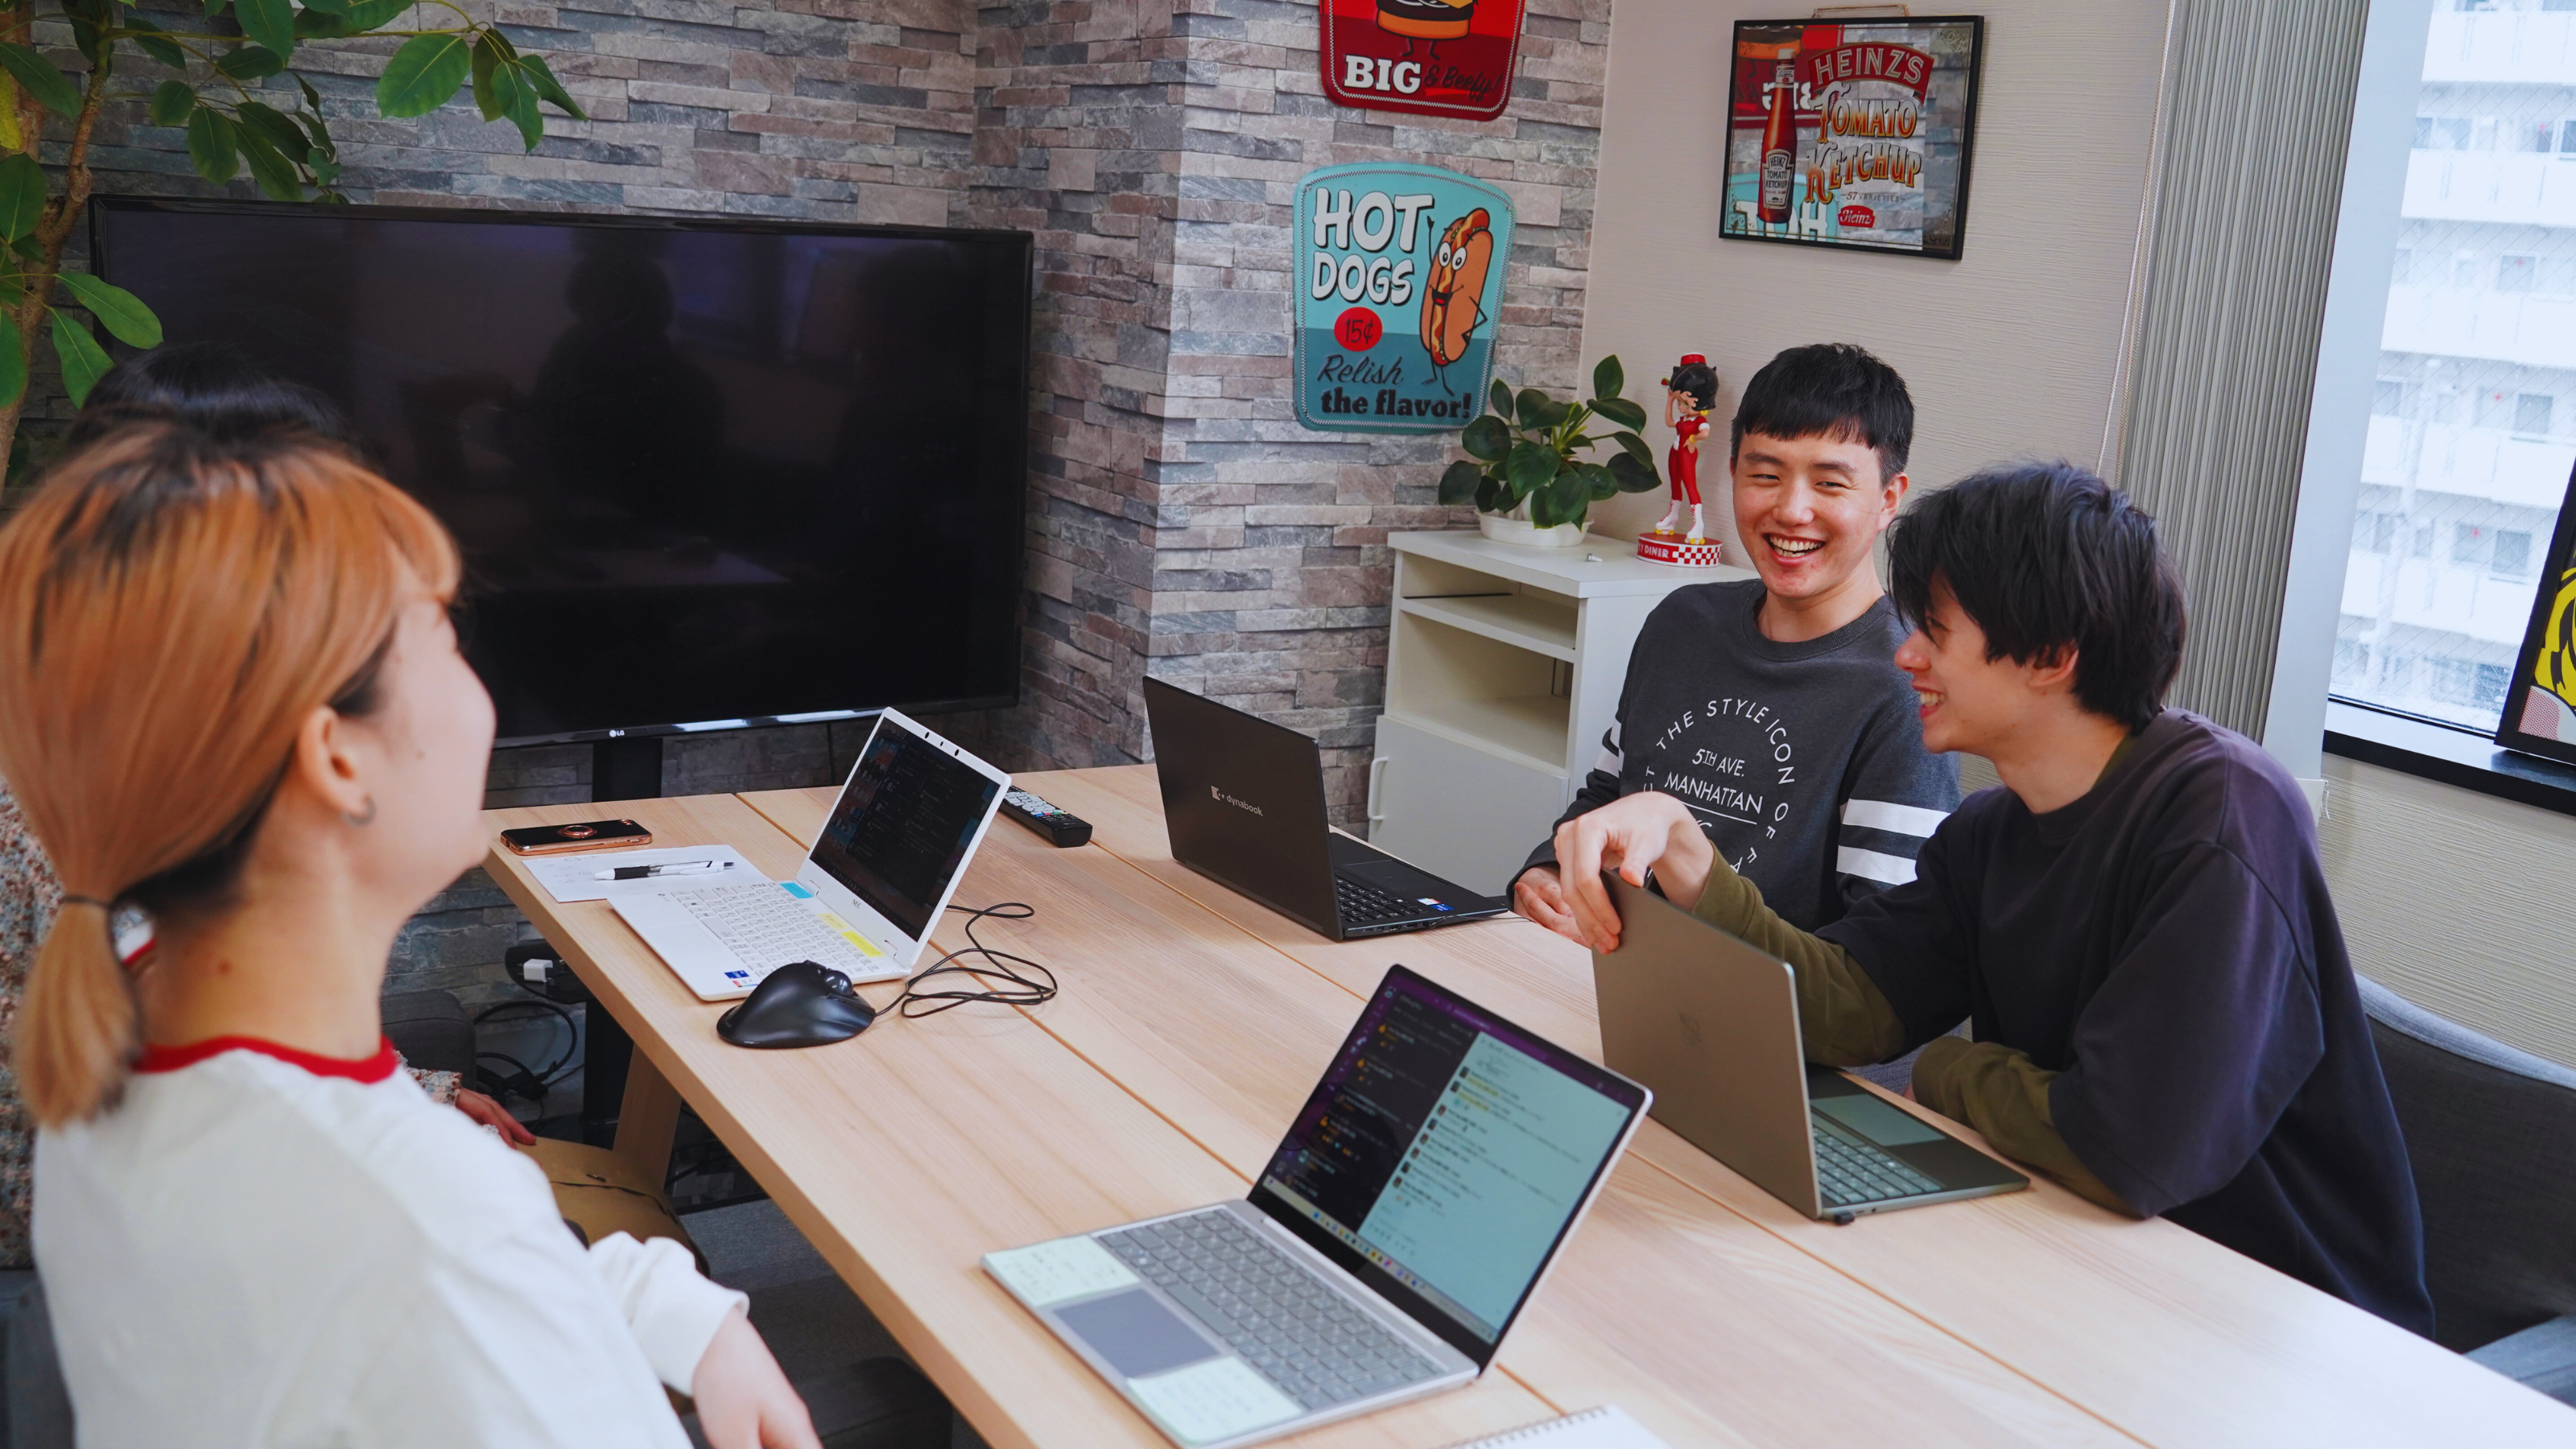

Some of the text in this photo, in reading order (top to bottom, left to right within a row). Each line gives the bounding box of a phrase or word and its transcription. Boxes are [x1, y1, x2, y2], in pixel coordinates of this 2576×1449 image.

[1344, 54, 1503, 102] BIG & Beefy!
[1814, 47, 1925, 85] HEINZ'S
[1807, 81, 1918, 143] TOMATO
[1767, 171, 1787, 180] TOMATO
[1770, 156, 1786, 167] HEINZ
[1804, 142, 1922, 204] KETCHUP
[1765, 180, 1788, 188] KETCHUP
[1846, 192, 1900, 202] 57 VARIETIES
[1314, 188, 1435, 254] HOT
[1840, 209, 1872, 225] Heinz
[1311, 251, 1414, 307] DOGS
[1344, 318, 1373, 345] 15¢
[1317, 354, 1404, 385] Relish
[1321, 386, 1472, 419] the flavor!
[1645, 544, 1669, 559] DINER
[1656, 710, 1695, 750] THE
[1707, 698, 1769, 724] STYLE
[1765, 719, 1795, 785] ICON
[1692, 748, 1745, 778] 5TH AVE.
[1226, 794, 1264, 817] dynabook
[1664, 771, 1763, 815] MANHATTAN
[852, 898, 862, 909] NEC
